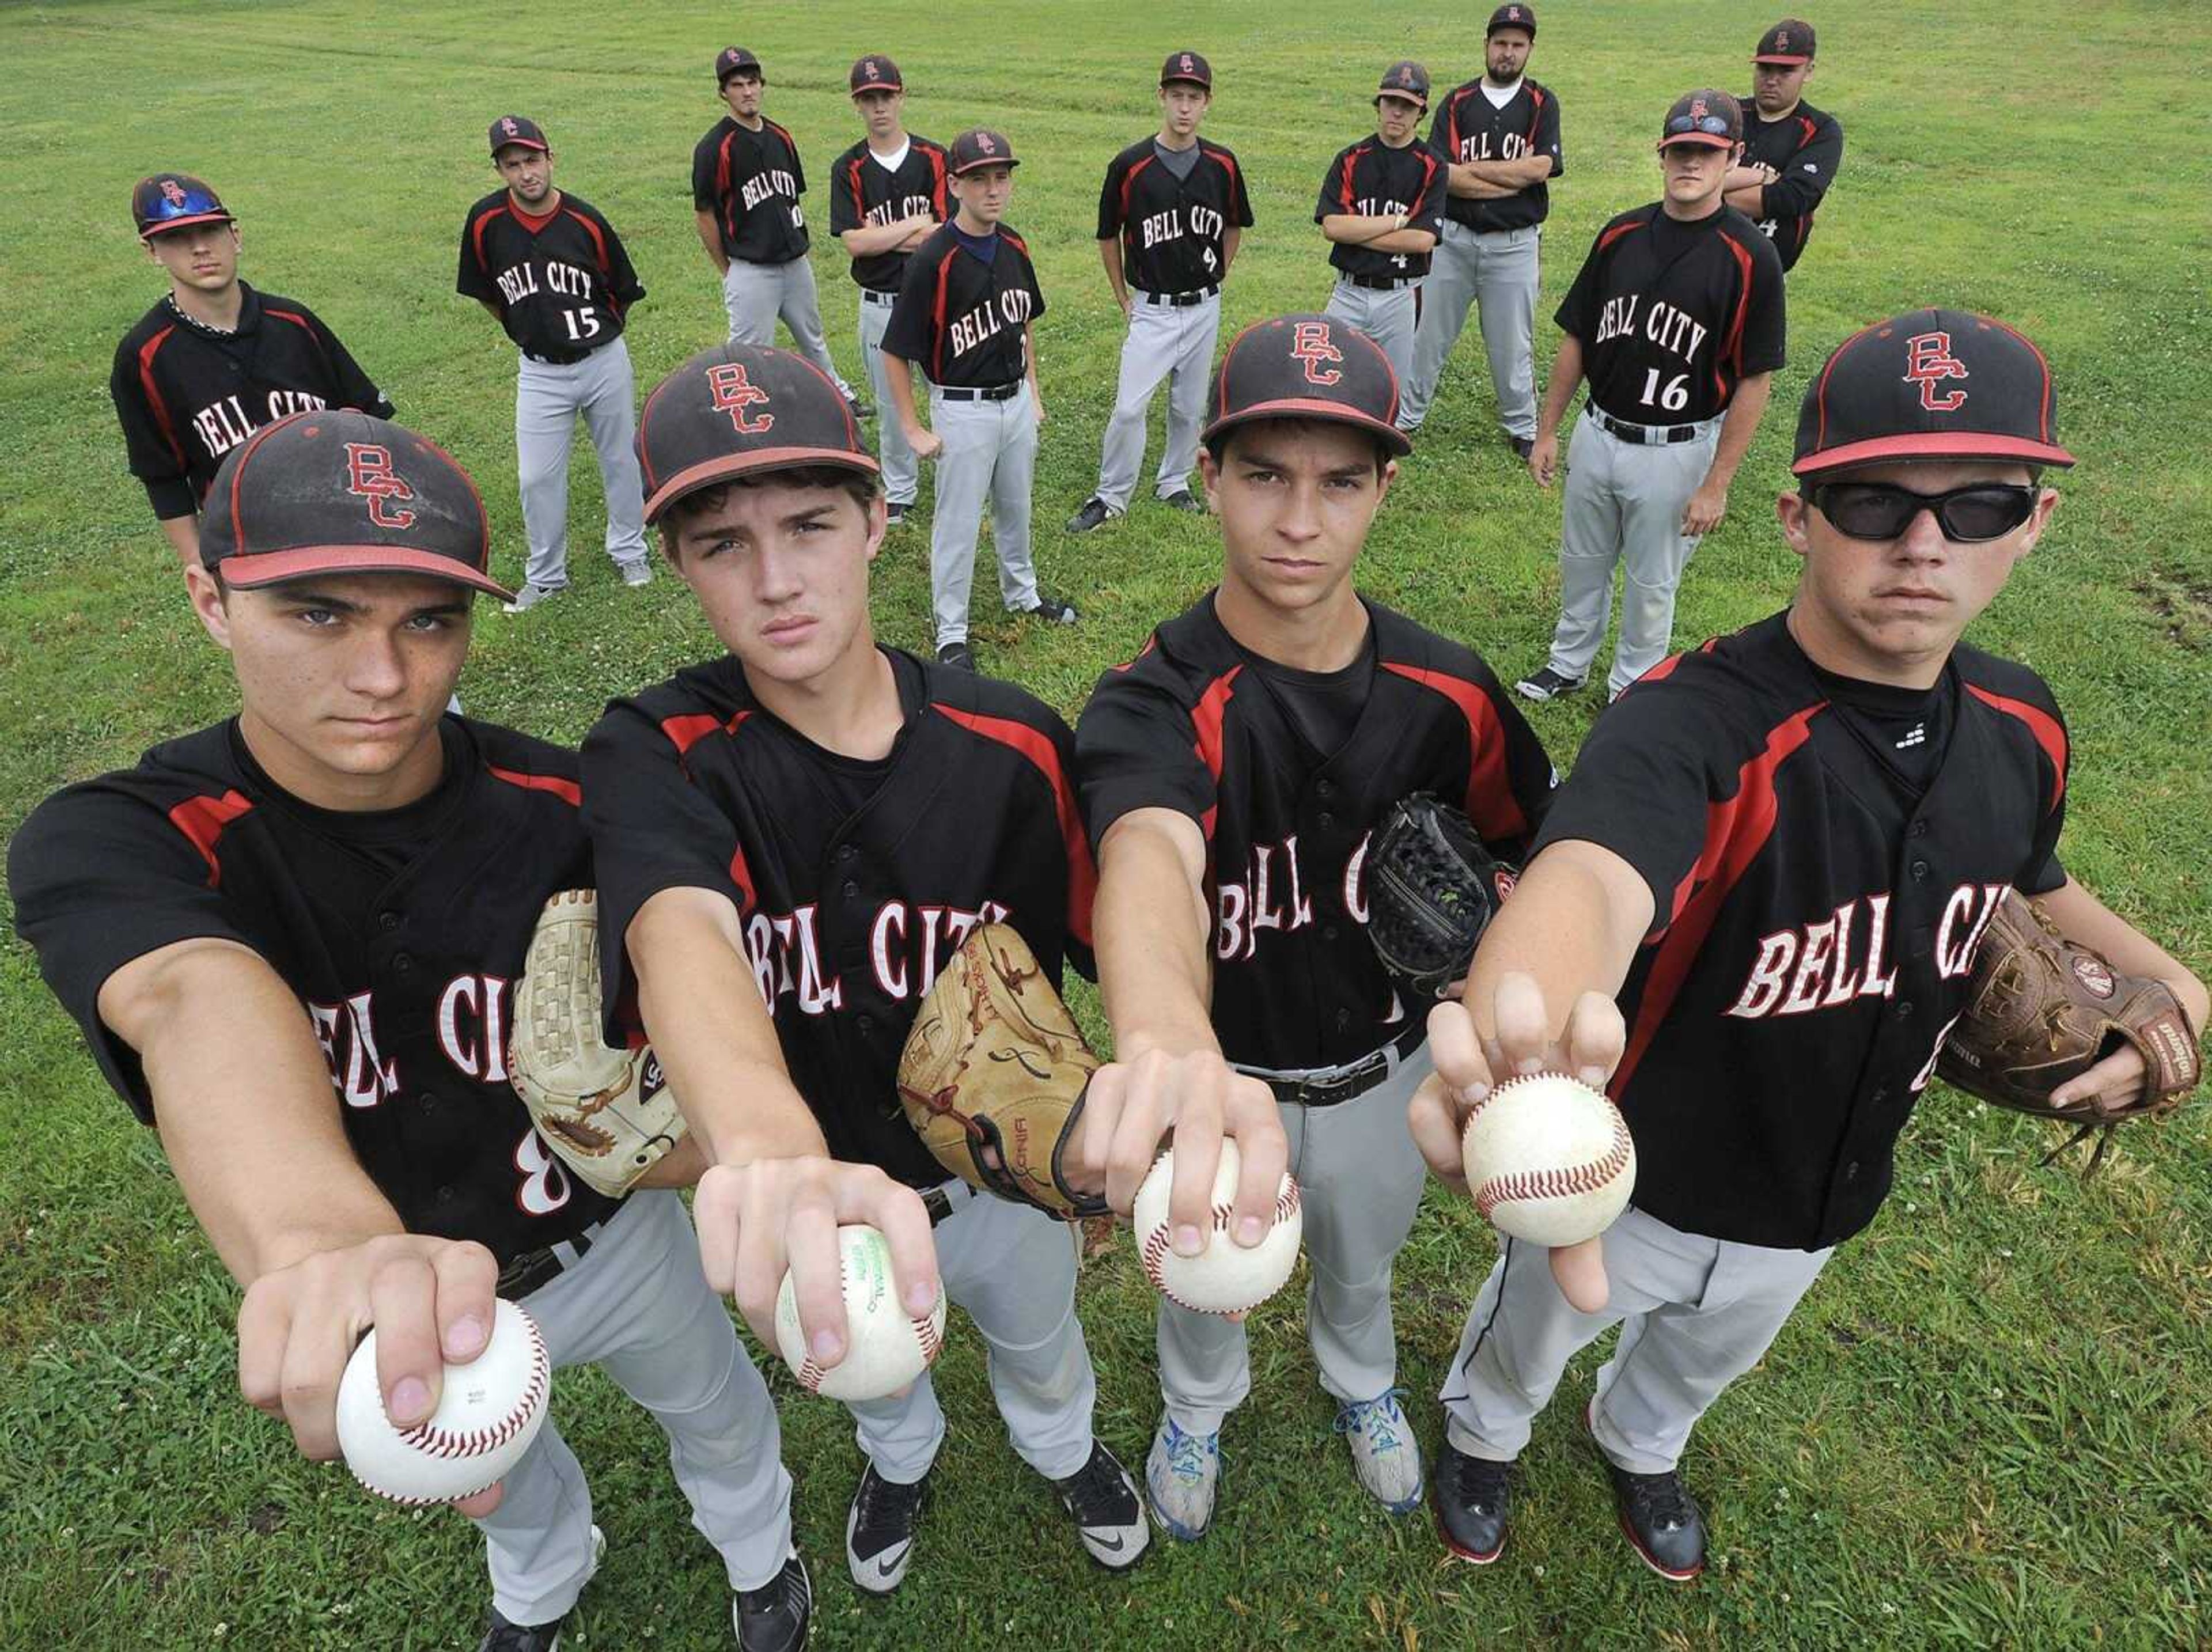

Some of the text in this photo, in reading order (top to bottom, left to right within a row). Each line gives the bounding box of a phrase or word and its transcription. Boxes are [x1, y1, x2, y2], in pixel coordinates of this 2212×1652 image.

[1142, 205, 1224, 249] BELL CITY
[497, 261, 592, 305] BELL CITY
[562, 306, 600, 340] 15
[950, 300, 1001, 358] BELL
[1646, 301, 1707, 365] CITY
[1639, 367, 1690, 411] 16
[1722, 892, 1900, 1018] BELL
